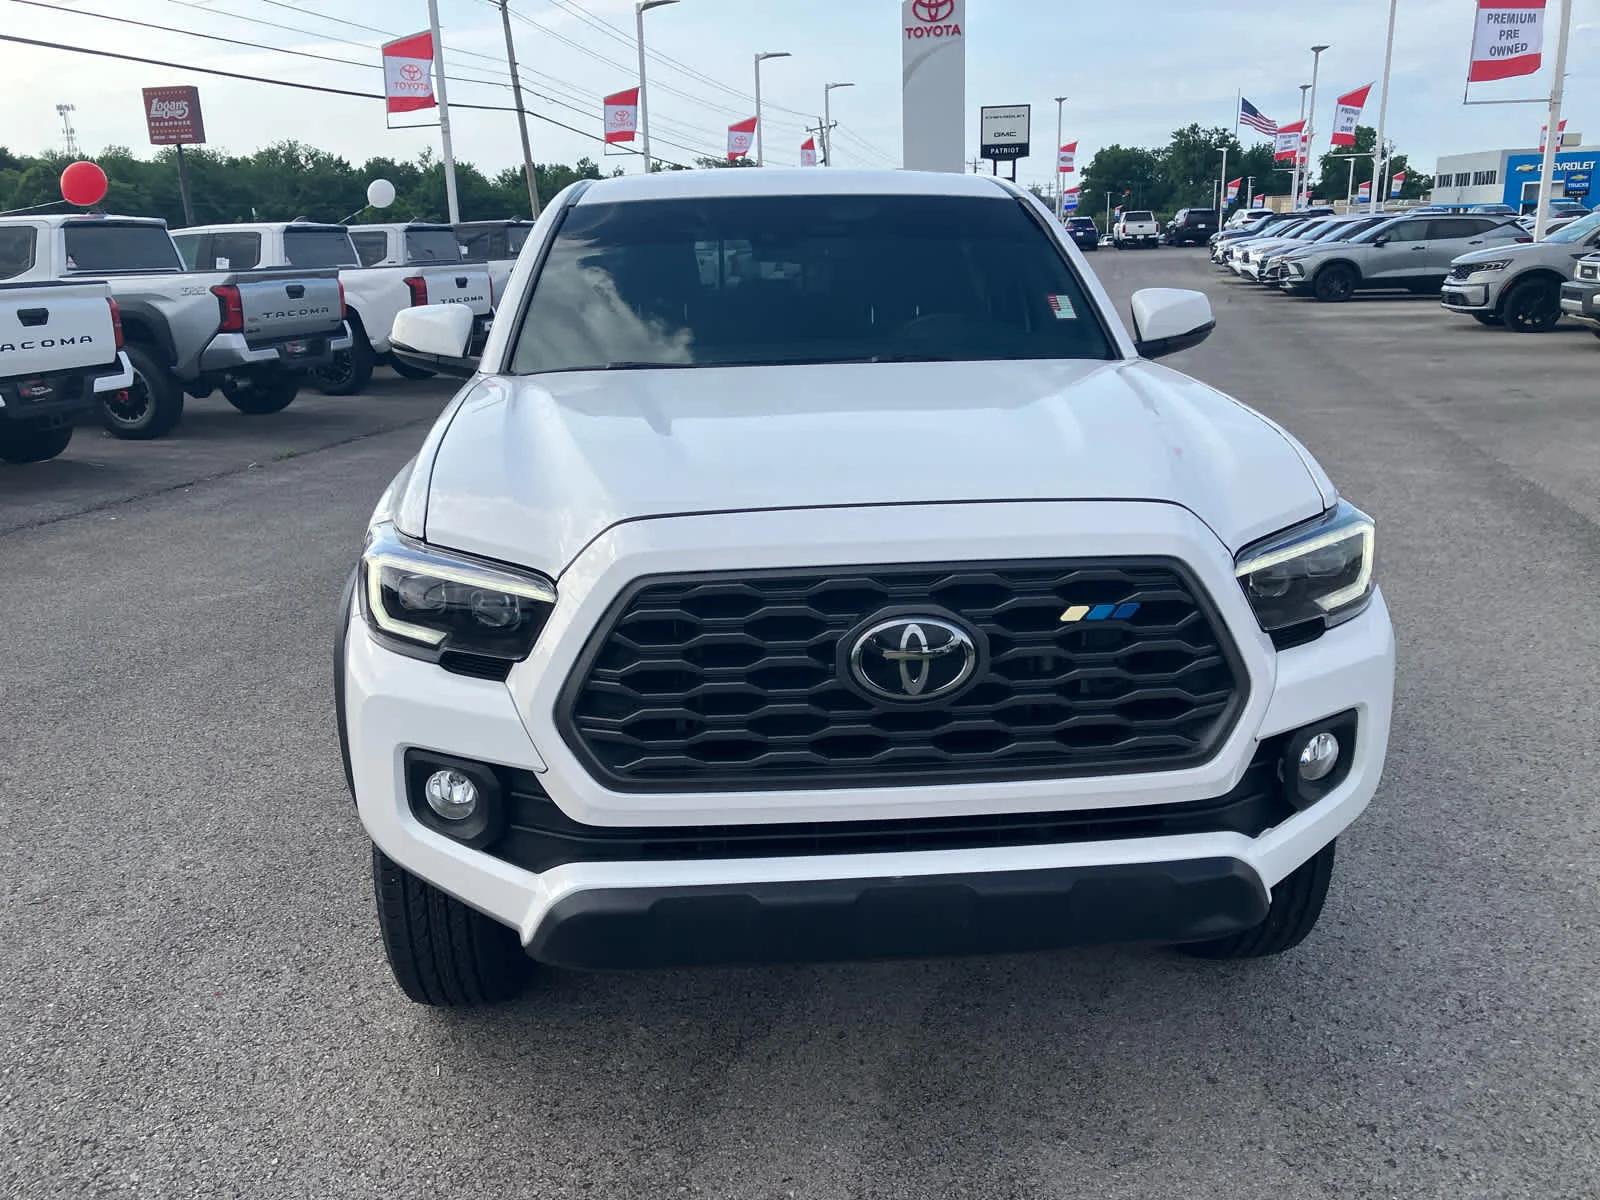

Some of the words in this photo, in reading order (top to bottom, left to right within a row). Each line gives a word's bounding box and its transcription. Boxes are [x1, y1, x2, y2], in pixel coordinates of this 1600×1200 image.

[1487, 13, 1537, 25] PREMIUM
[905, 24, 962, 40] TOYOTA
[1499, 29, 1520, 41] PRE
[1489, 42, 1529, 57] OWNED
[393, 81, 430, 92] TOYOTA
[990, 147, 1019, 155] PATRIOT
[1537, 160, 1596, 172] CEVROLET
[441, 295, 484, 304] TACOMA
[263, 307, 329, 319] TACOMA
[0, 335, 93, 352] ACOMA
